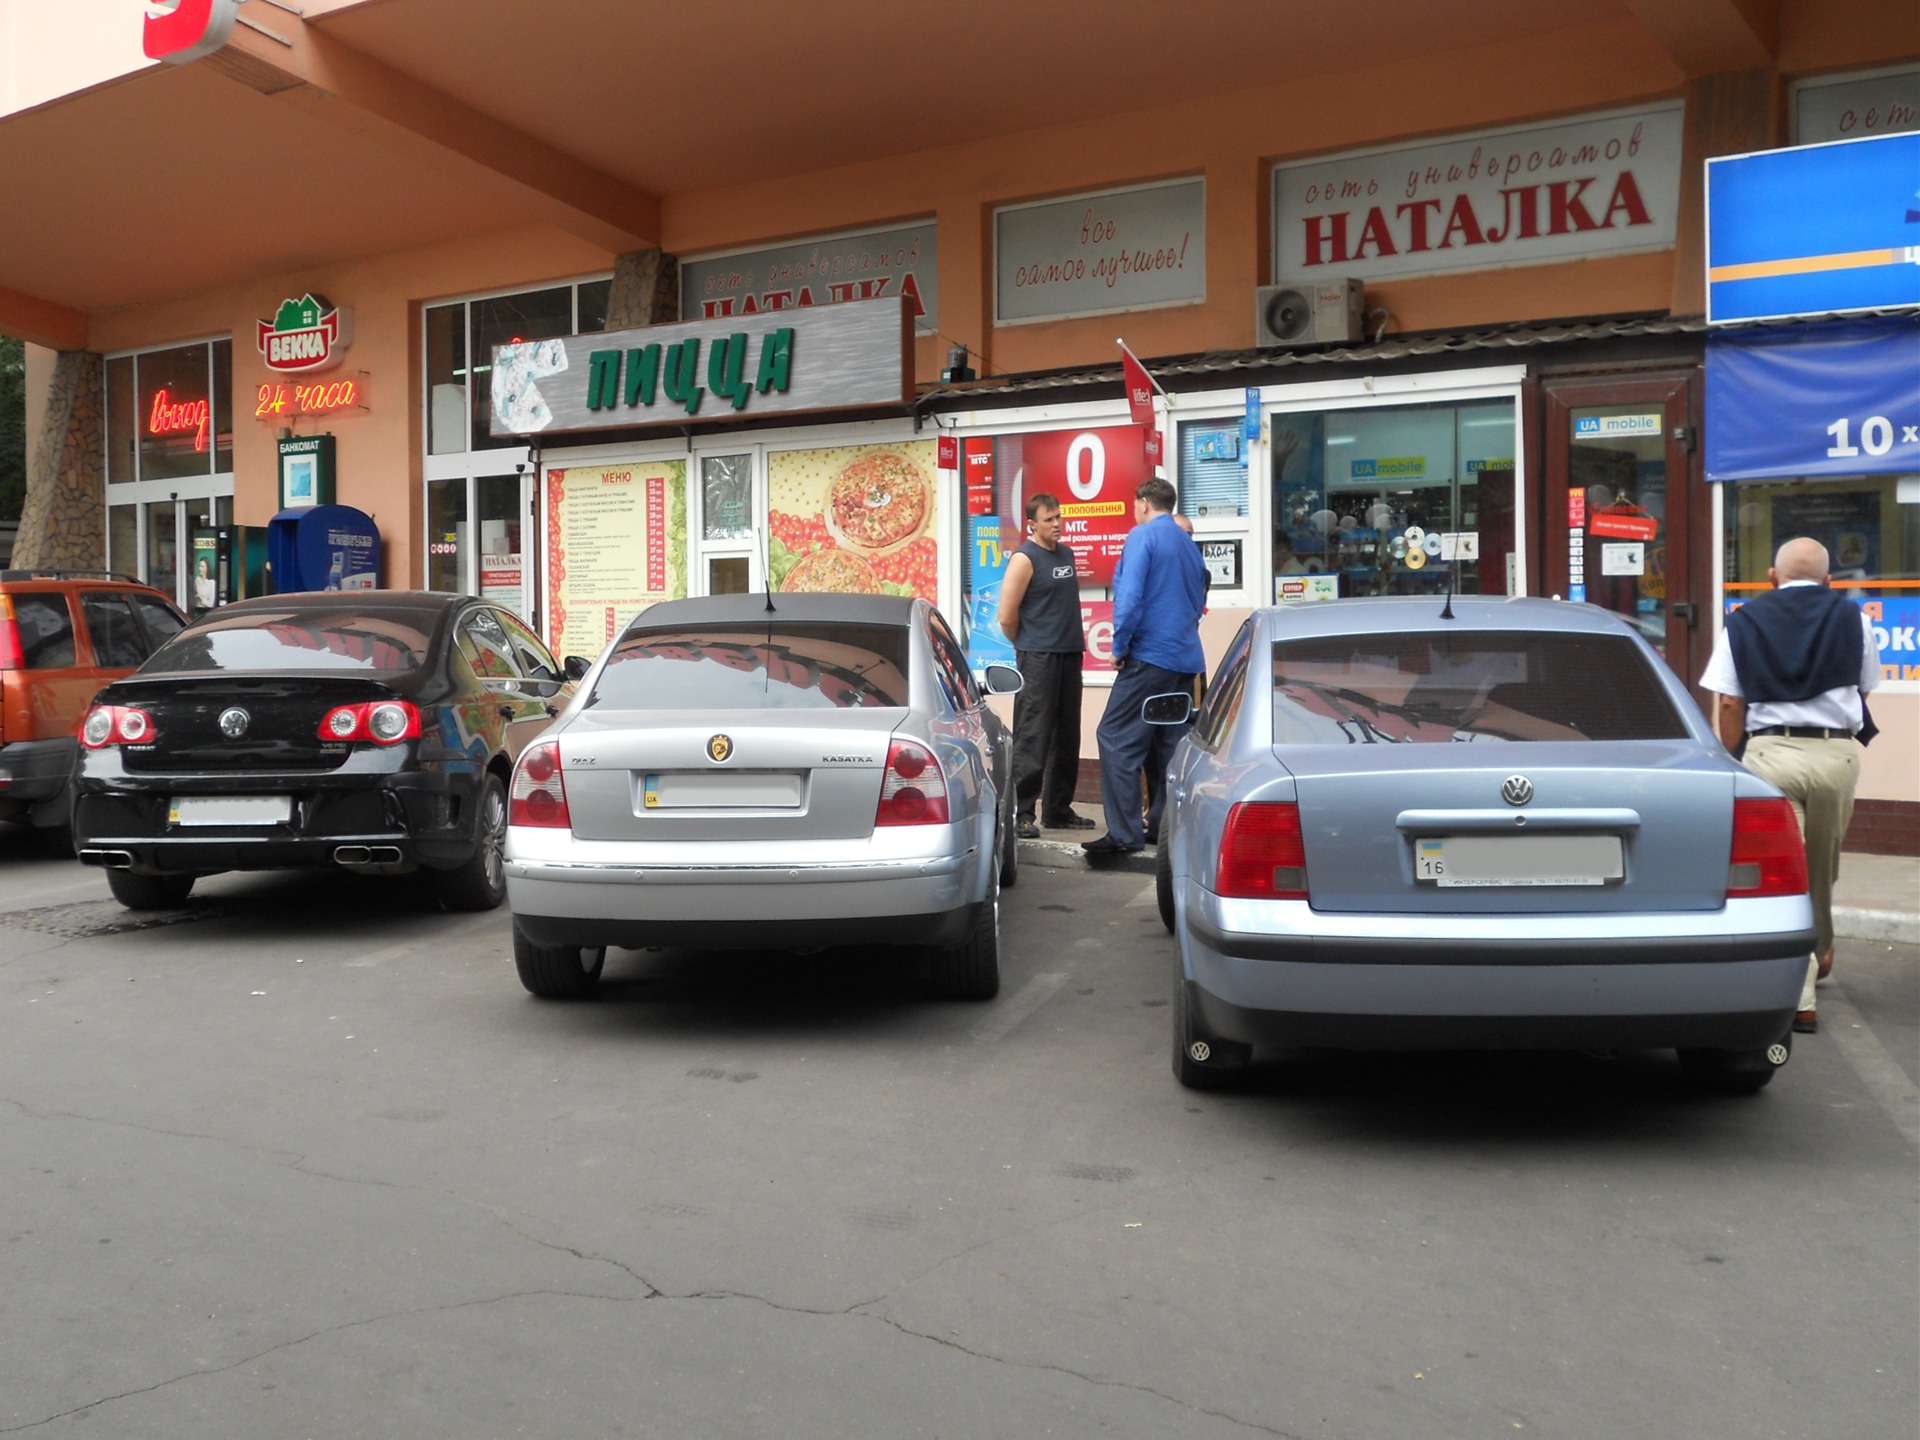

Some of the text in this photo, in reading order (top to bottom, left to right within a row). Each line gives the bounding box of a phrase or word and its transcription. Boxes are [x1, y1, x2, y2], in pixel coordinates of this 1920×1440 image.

[1839, 103, 1917, 133] сет
[1305, 121, 1644, 204] сеть универсамов
[1080, 207, 1117, 245] все
[1302, 170, 1653, 268] НАТАЛКА
[768, 235, 921, 291] универсамов
[1015, 231, 1190, 288] самое лучшее!
[269, 331, 327, 363] ВЕККА
[586, 327, 795, 414] ПИЦЦА
[255, 380, 357, 417] 24 часа
[1580, 416, 1654, 431] UA mobile
[1826, 415, 1894, 458] 10
[279, 440, 321, 454] БАНКОМАТ
[970, 456, 988, 465] МТС
[1066, 432, 1106, 501] 0
[1355, 460, 1422, 475] UA mobile
[1470, 459, 1515, 471] UA mob
[601, 471, 632, 484] МЕНЮ
[1068, 504, 1123, 515] ПОПОВНЕННЯ
[1065, 520, 1089, 533] МТС
[1101, 545, 1107, 556] 1
[821, 755, 873, 763] KASATKA
[646, 795, 657, 803] UA
[1424, 861, 1444, 875] 16
